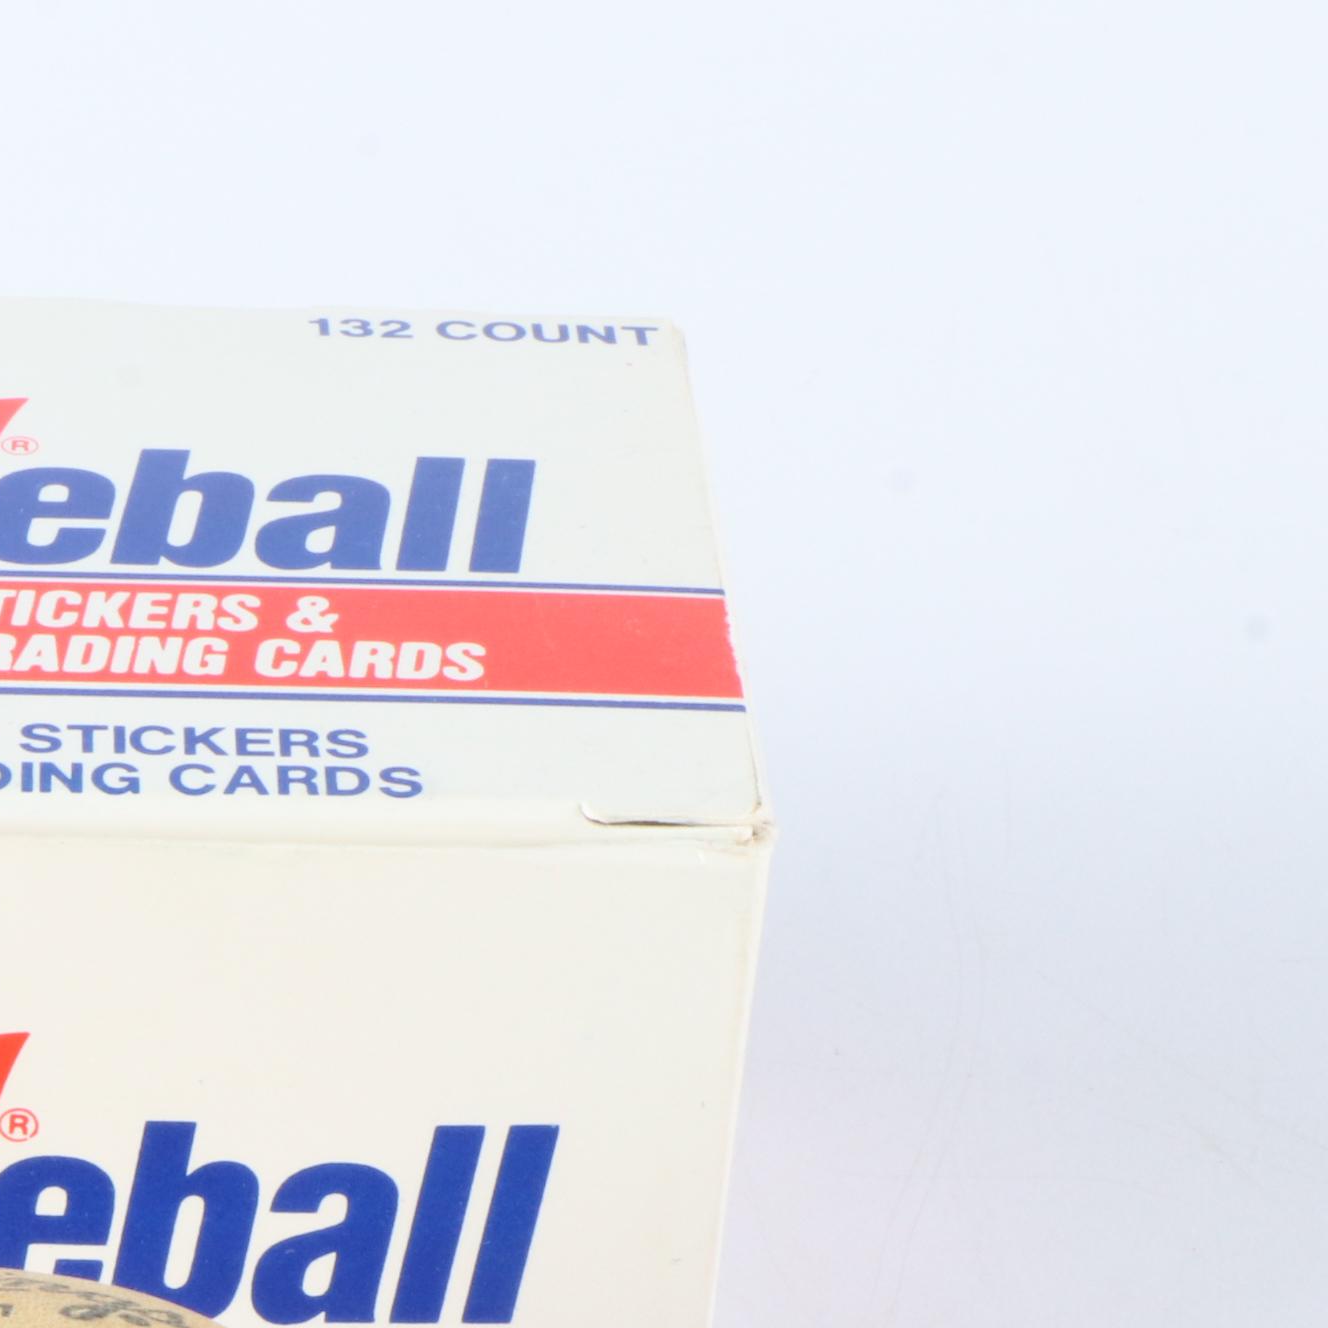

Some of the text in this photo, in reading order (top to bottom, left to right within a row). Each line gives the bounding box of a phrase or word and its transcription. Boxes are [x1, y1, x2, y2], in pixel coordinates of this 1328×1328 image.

[308, 317, 659, 347] 132 COUNT
[284, 595, 340, 634] &
[253, 638, 487, 683] CARDS
[19, 721, 370, 760] STICKERS
[168, 762, 425, 799] CARDS
